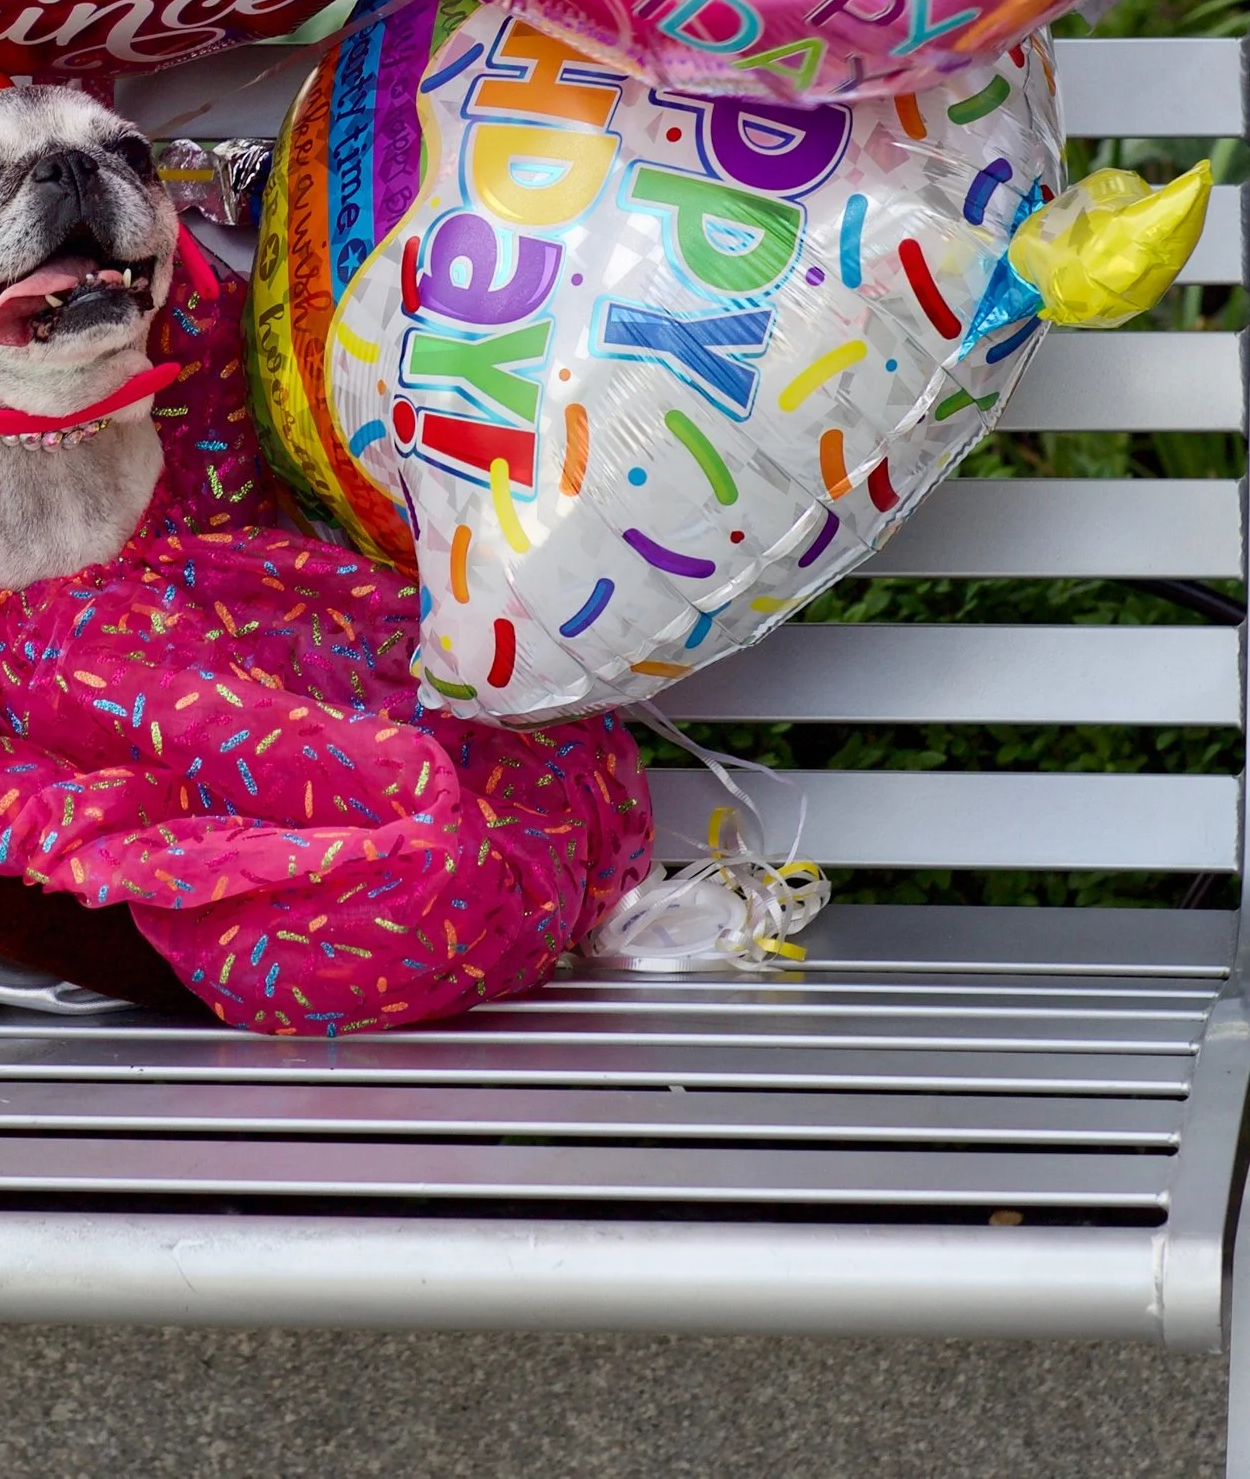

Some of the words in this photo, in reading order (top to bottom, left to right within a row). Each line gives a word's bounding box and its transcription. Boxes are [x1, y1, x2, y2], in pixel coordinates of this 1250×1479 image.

[292, 173, 315, 212] a
[332, 123, 369, 235] time
[291, 212, 333, 332] wish
[589, 85, 853, 422] PPY
